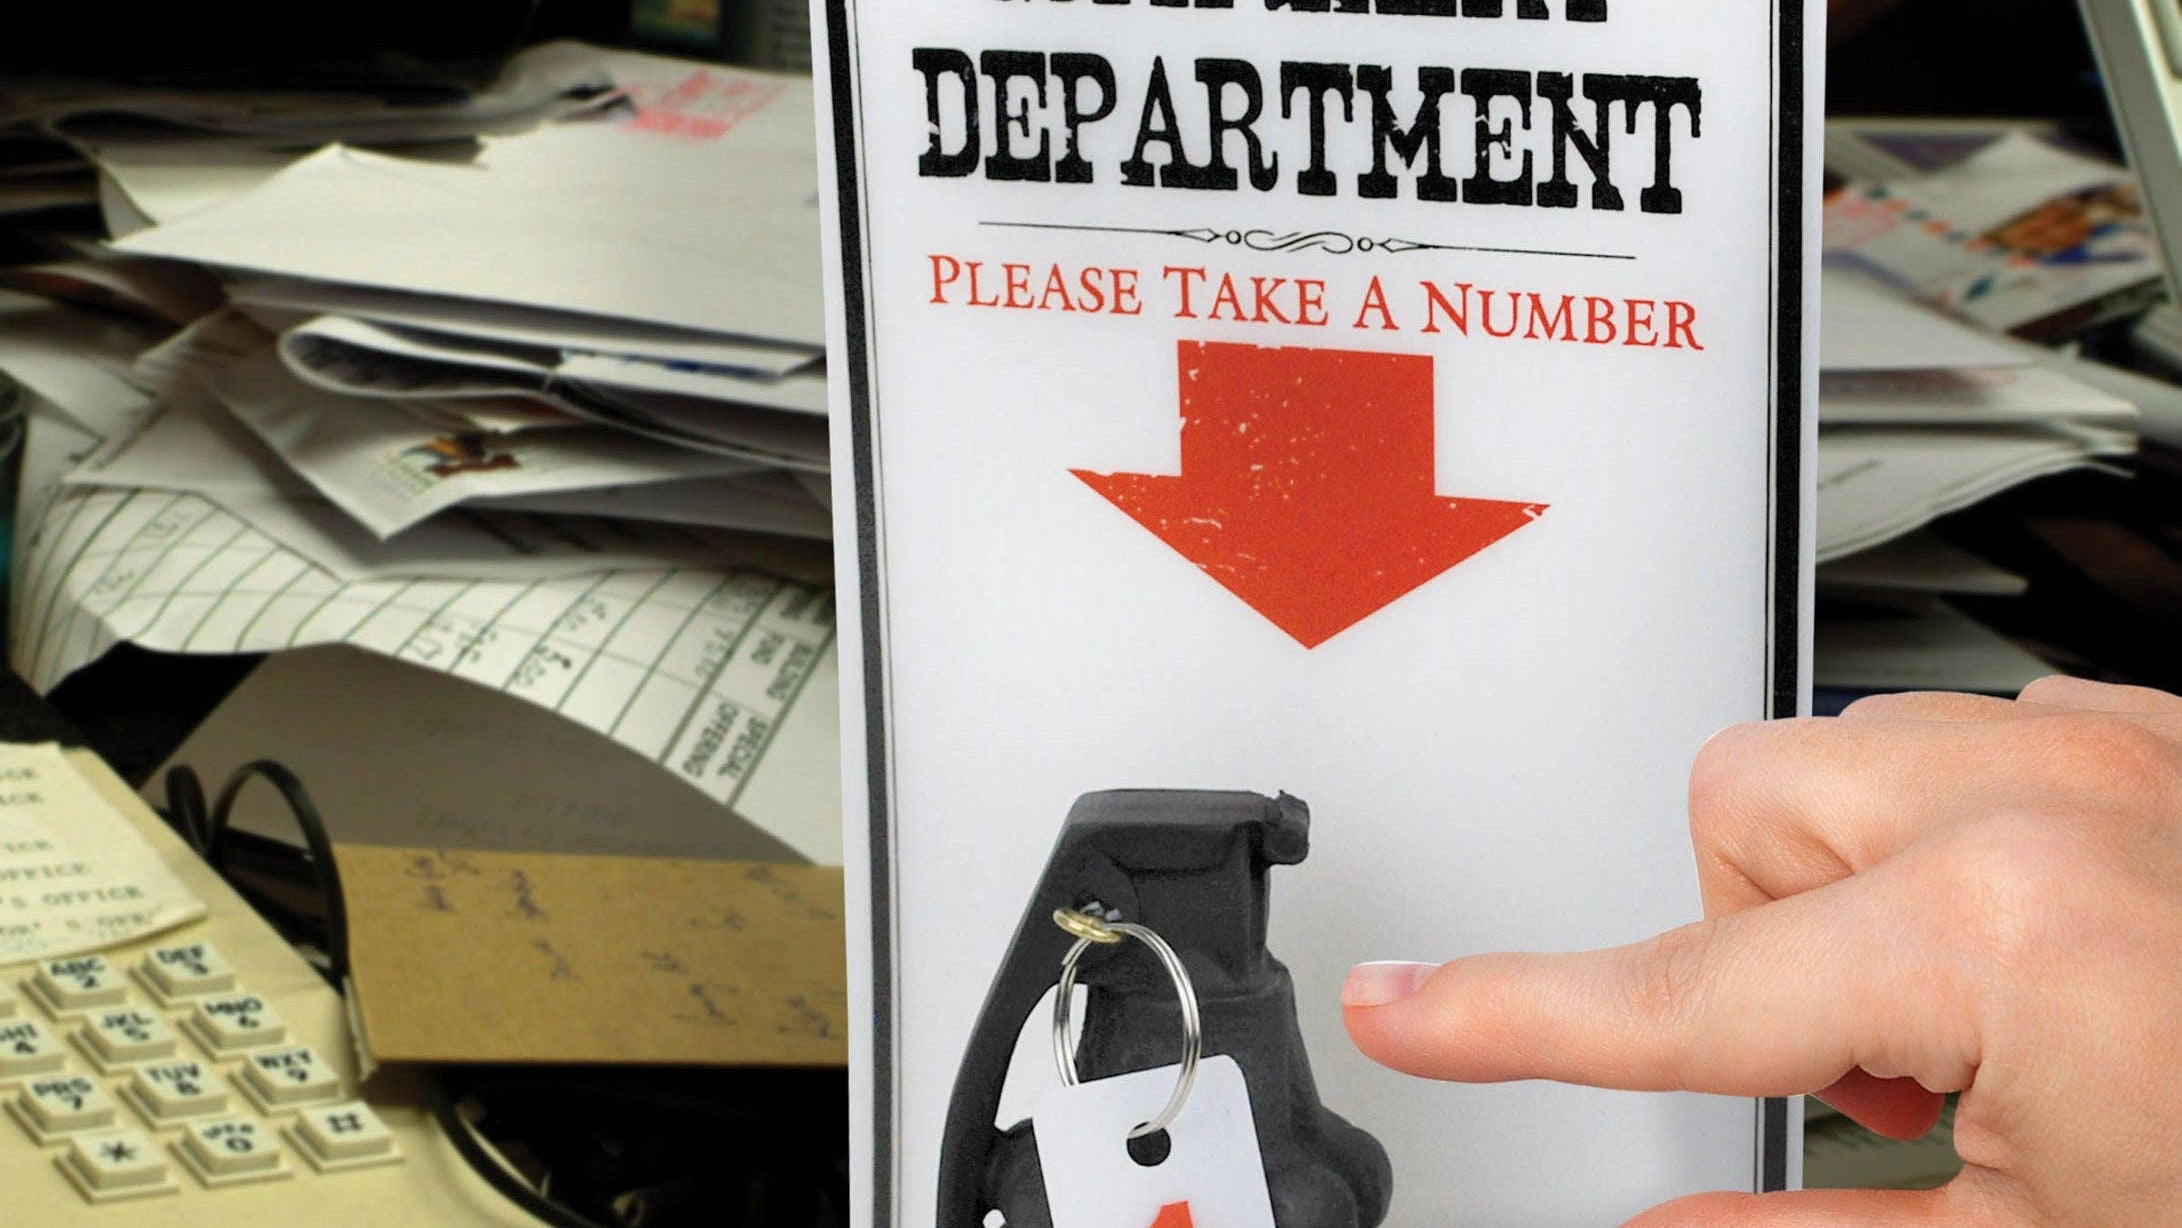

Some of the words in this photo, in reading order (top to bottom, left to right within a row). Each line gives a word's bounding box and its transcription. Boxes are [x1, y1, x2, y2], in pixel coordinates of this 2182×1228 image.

[912, 47, 1701, 214] DEPARTMENT
[928, 254, 1143, 315] PLEASE
[1163, 265, 1329, 326] TAKE
[1353, 275, 1399, 331] A
[1420, 280, 1704, 350] NUMBER
[683, 701, 739, 778] OFFERING
[717, 716, 769, 779] SPECIAL
[41, 884, 145, 905] OFFICE
